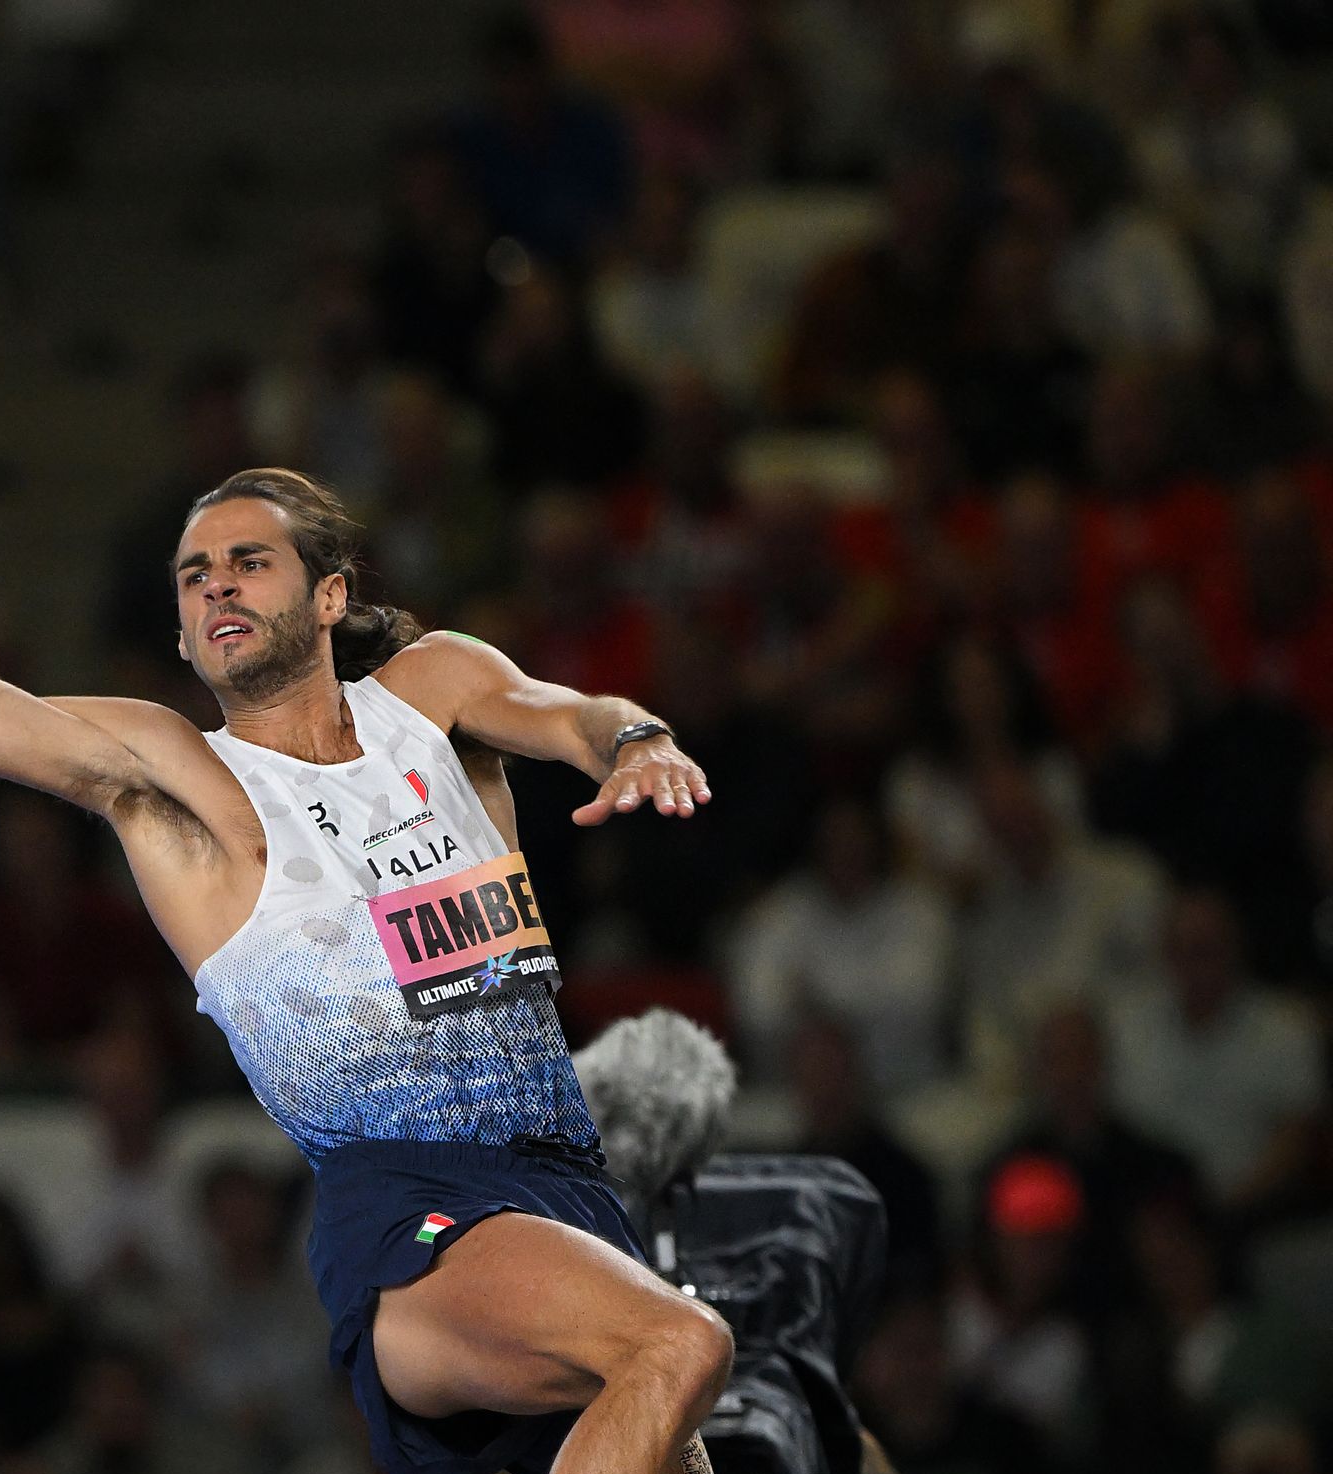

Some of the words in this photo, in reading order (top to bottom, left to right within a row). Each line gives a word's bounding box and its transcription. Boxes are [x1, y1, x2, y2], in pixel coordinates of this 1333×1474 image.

[363, 810, 434, 848] FRECCIAROSSA
[367, 834, 461, 880] IALIA
[385, 871, 545, 964] TAMBE
[417, 977, 479, 1006] ULTIMATE
